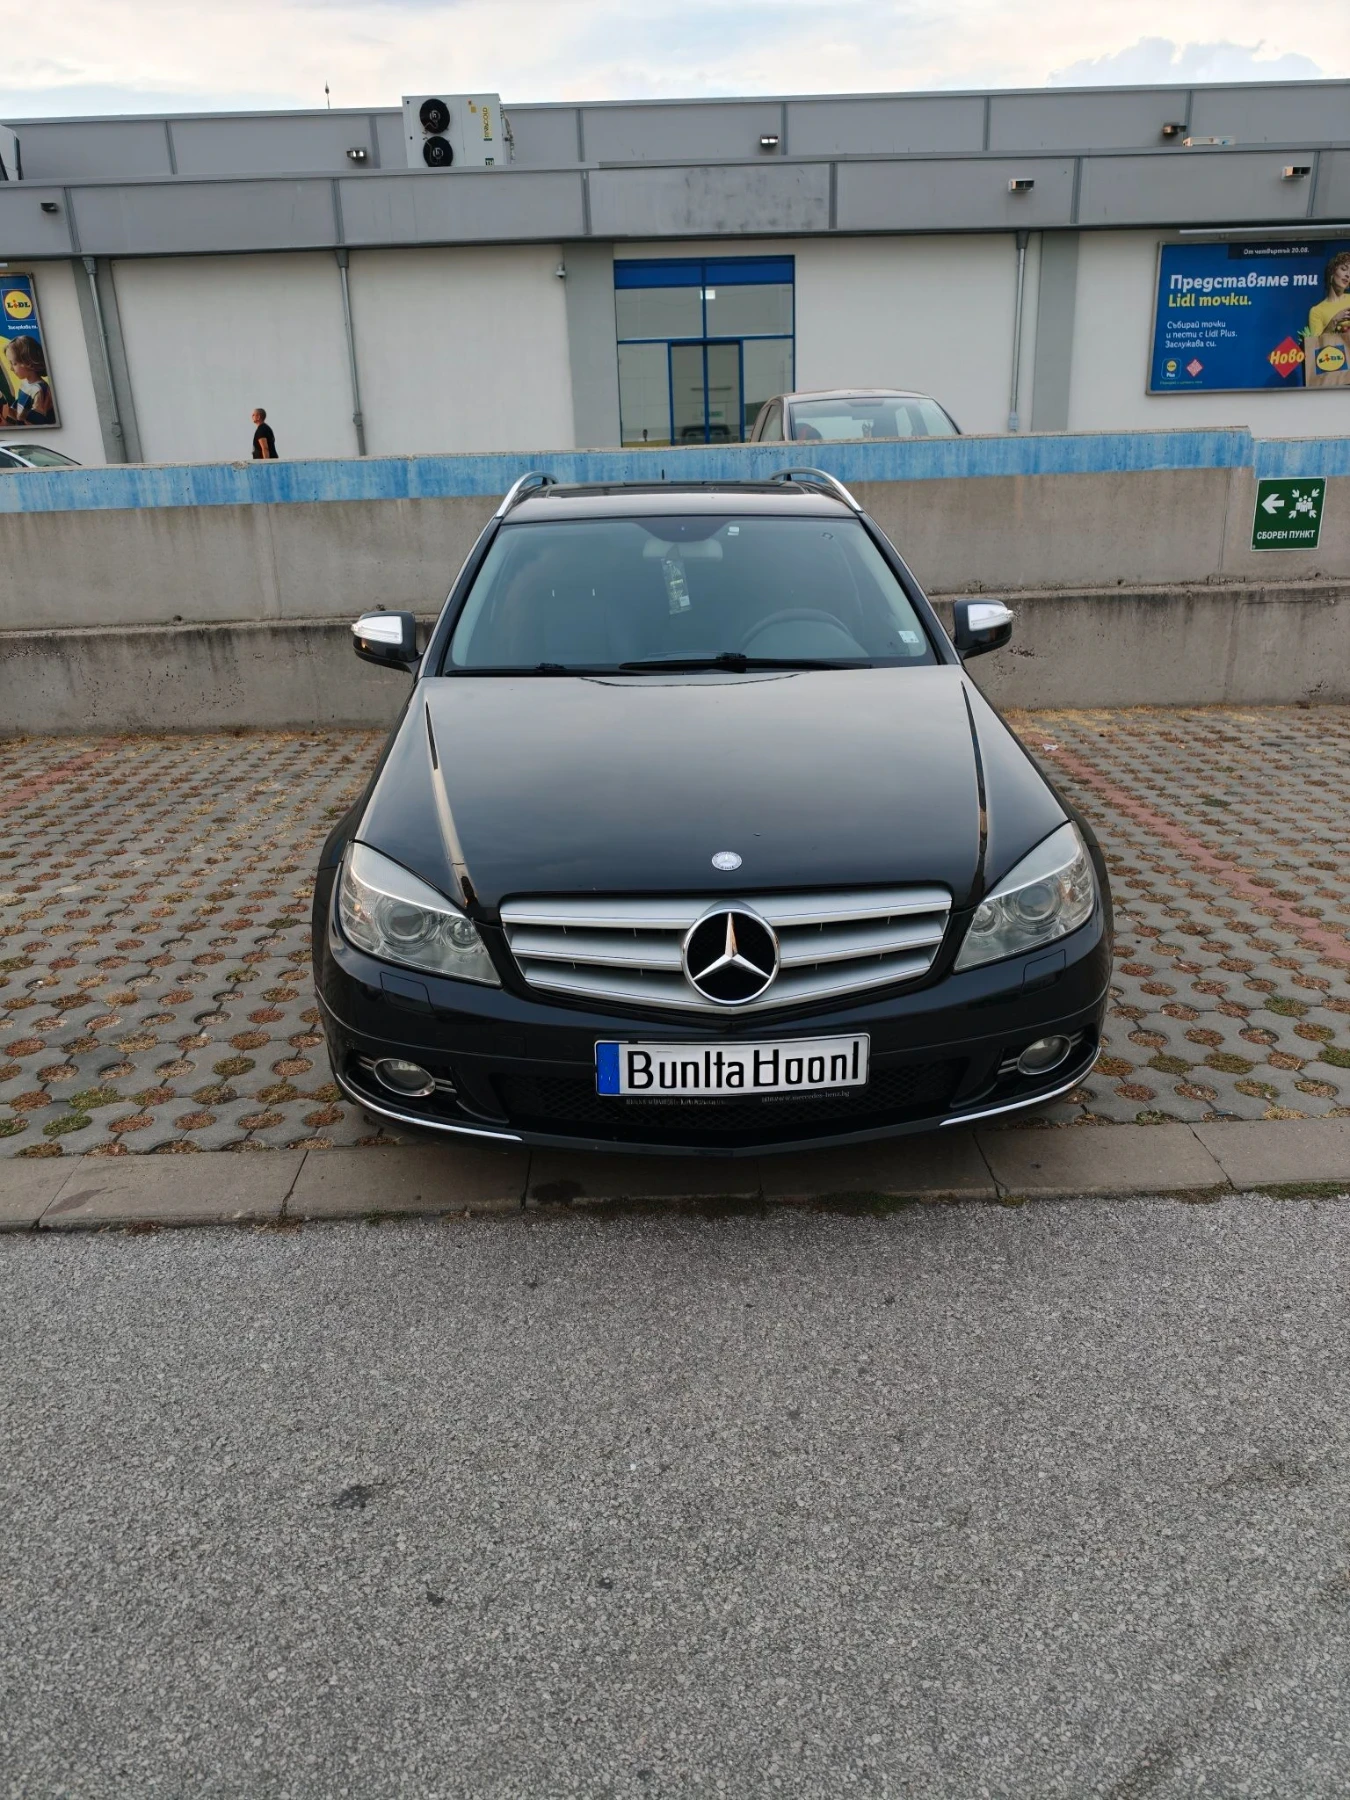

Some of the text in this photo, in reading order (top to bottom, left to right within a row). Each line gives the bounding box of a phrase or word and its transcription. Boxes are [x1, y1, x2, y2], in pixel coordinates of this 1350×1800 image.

[1170, 272, 1318, 293] Представяме ти
[1168, 292, 1252, 308] Lidl точки.
[1166, 320, 1226, 330] Събирай точки
[1172, 331, 1197, 339] пести
[1204, 330, 1218, 338] Lidl
[1220, 329, 1238, 337] Plus.
[1165, 339, 1217, 349] Заслужава си.
[1269, 348, 1305, 365] Ново
[1256, 529, 1316, 540] СБОРЕН ПУНКТ
